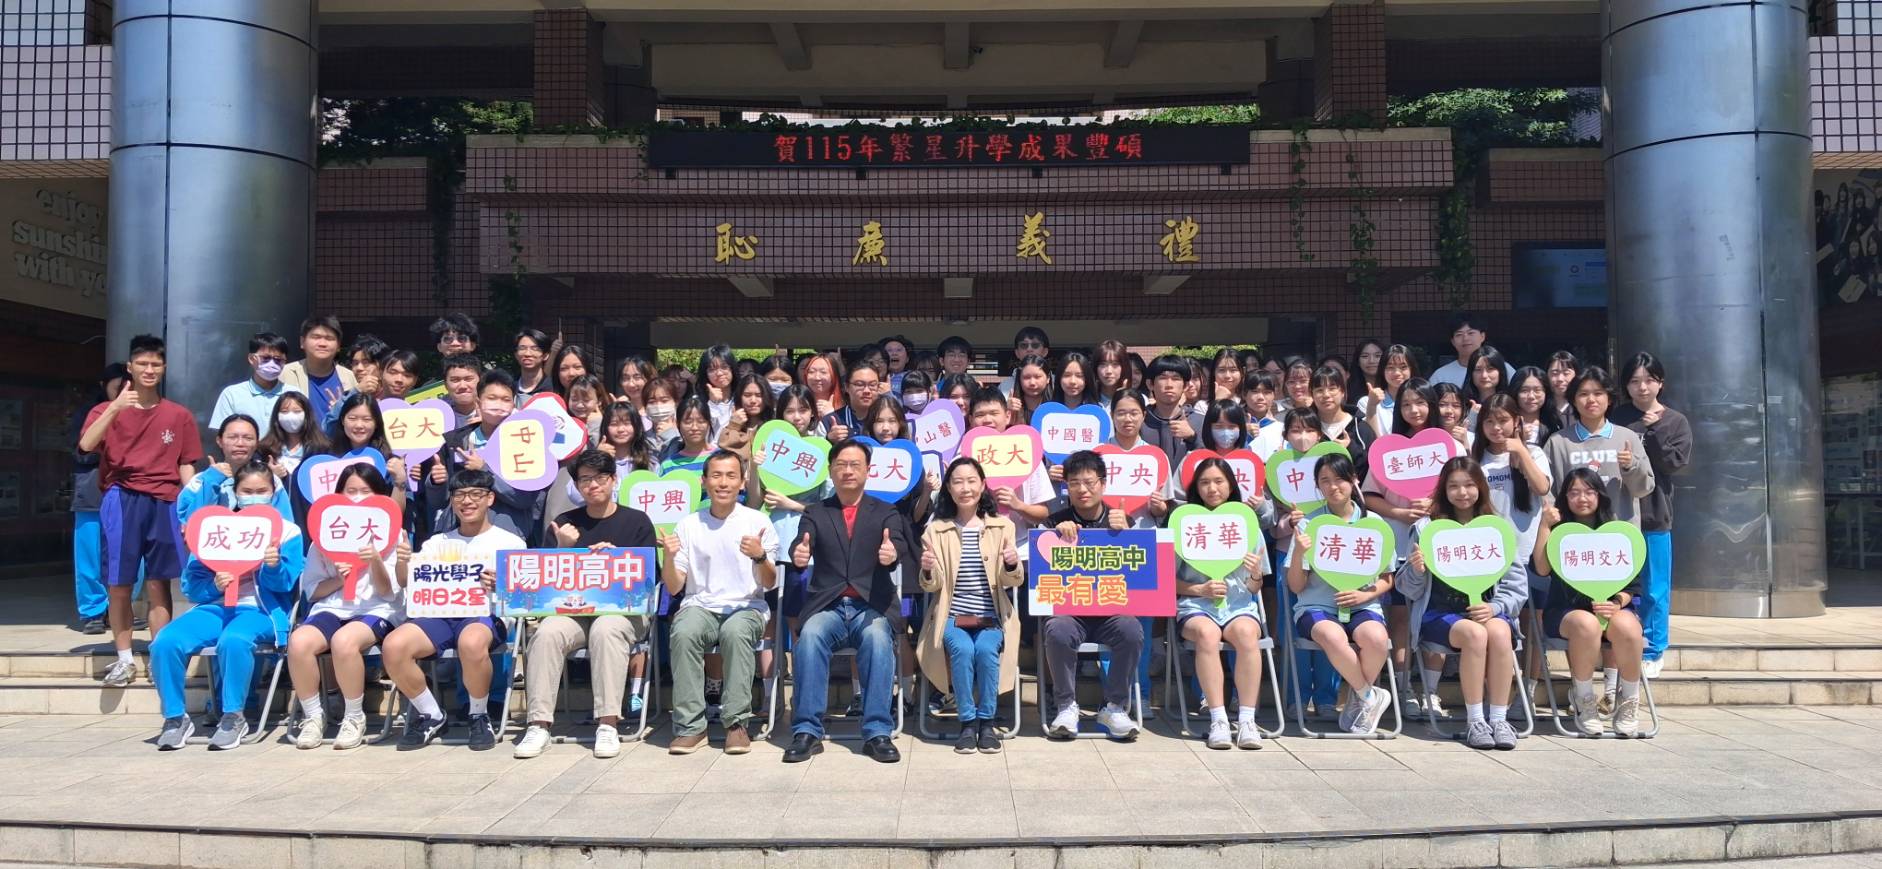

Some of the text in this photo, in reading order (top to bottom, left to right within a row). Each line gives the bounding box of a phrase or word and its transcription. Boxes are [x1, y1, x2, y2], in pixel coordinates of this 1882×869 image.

[775, 133, 1143, 162] 賀115年繁星升學成果豐碩
[15, 252, 76, 288] with
[388, 416, 441, 440] 台大
[915, 421, 952, 444] 山醫
[1048, 426, 1094, 443] 中國醫
[771, 439, 818, 478] 中興
[977, 444, 1029, 466] 政大
[1388, 451, 1446, 475] 臺師大
[1105, 461, 1153, 486] 中央
[638, 489, 686, 513] 中興
[202, 524, 266, 551] 成功
[329, 516, 383, 542] 台大
[1185, 522, 1243, 550] 清華
[1051, 545, 1146, 571] 陽明高中
[1319, 533, 1377, 565] 清華
[1436, 543, 1503, 564] 陽明交大
[1563, 547, 1630, 567] 陽明交大
[413, 563, 485, 583] 陽光學子
[507, 552, 645, 591] 陽明高中
[412, 588, 487, 606] 明日之星
[1036, 574, 1128, 606] 最有愛
